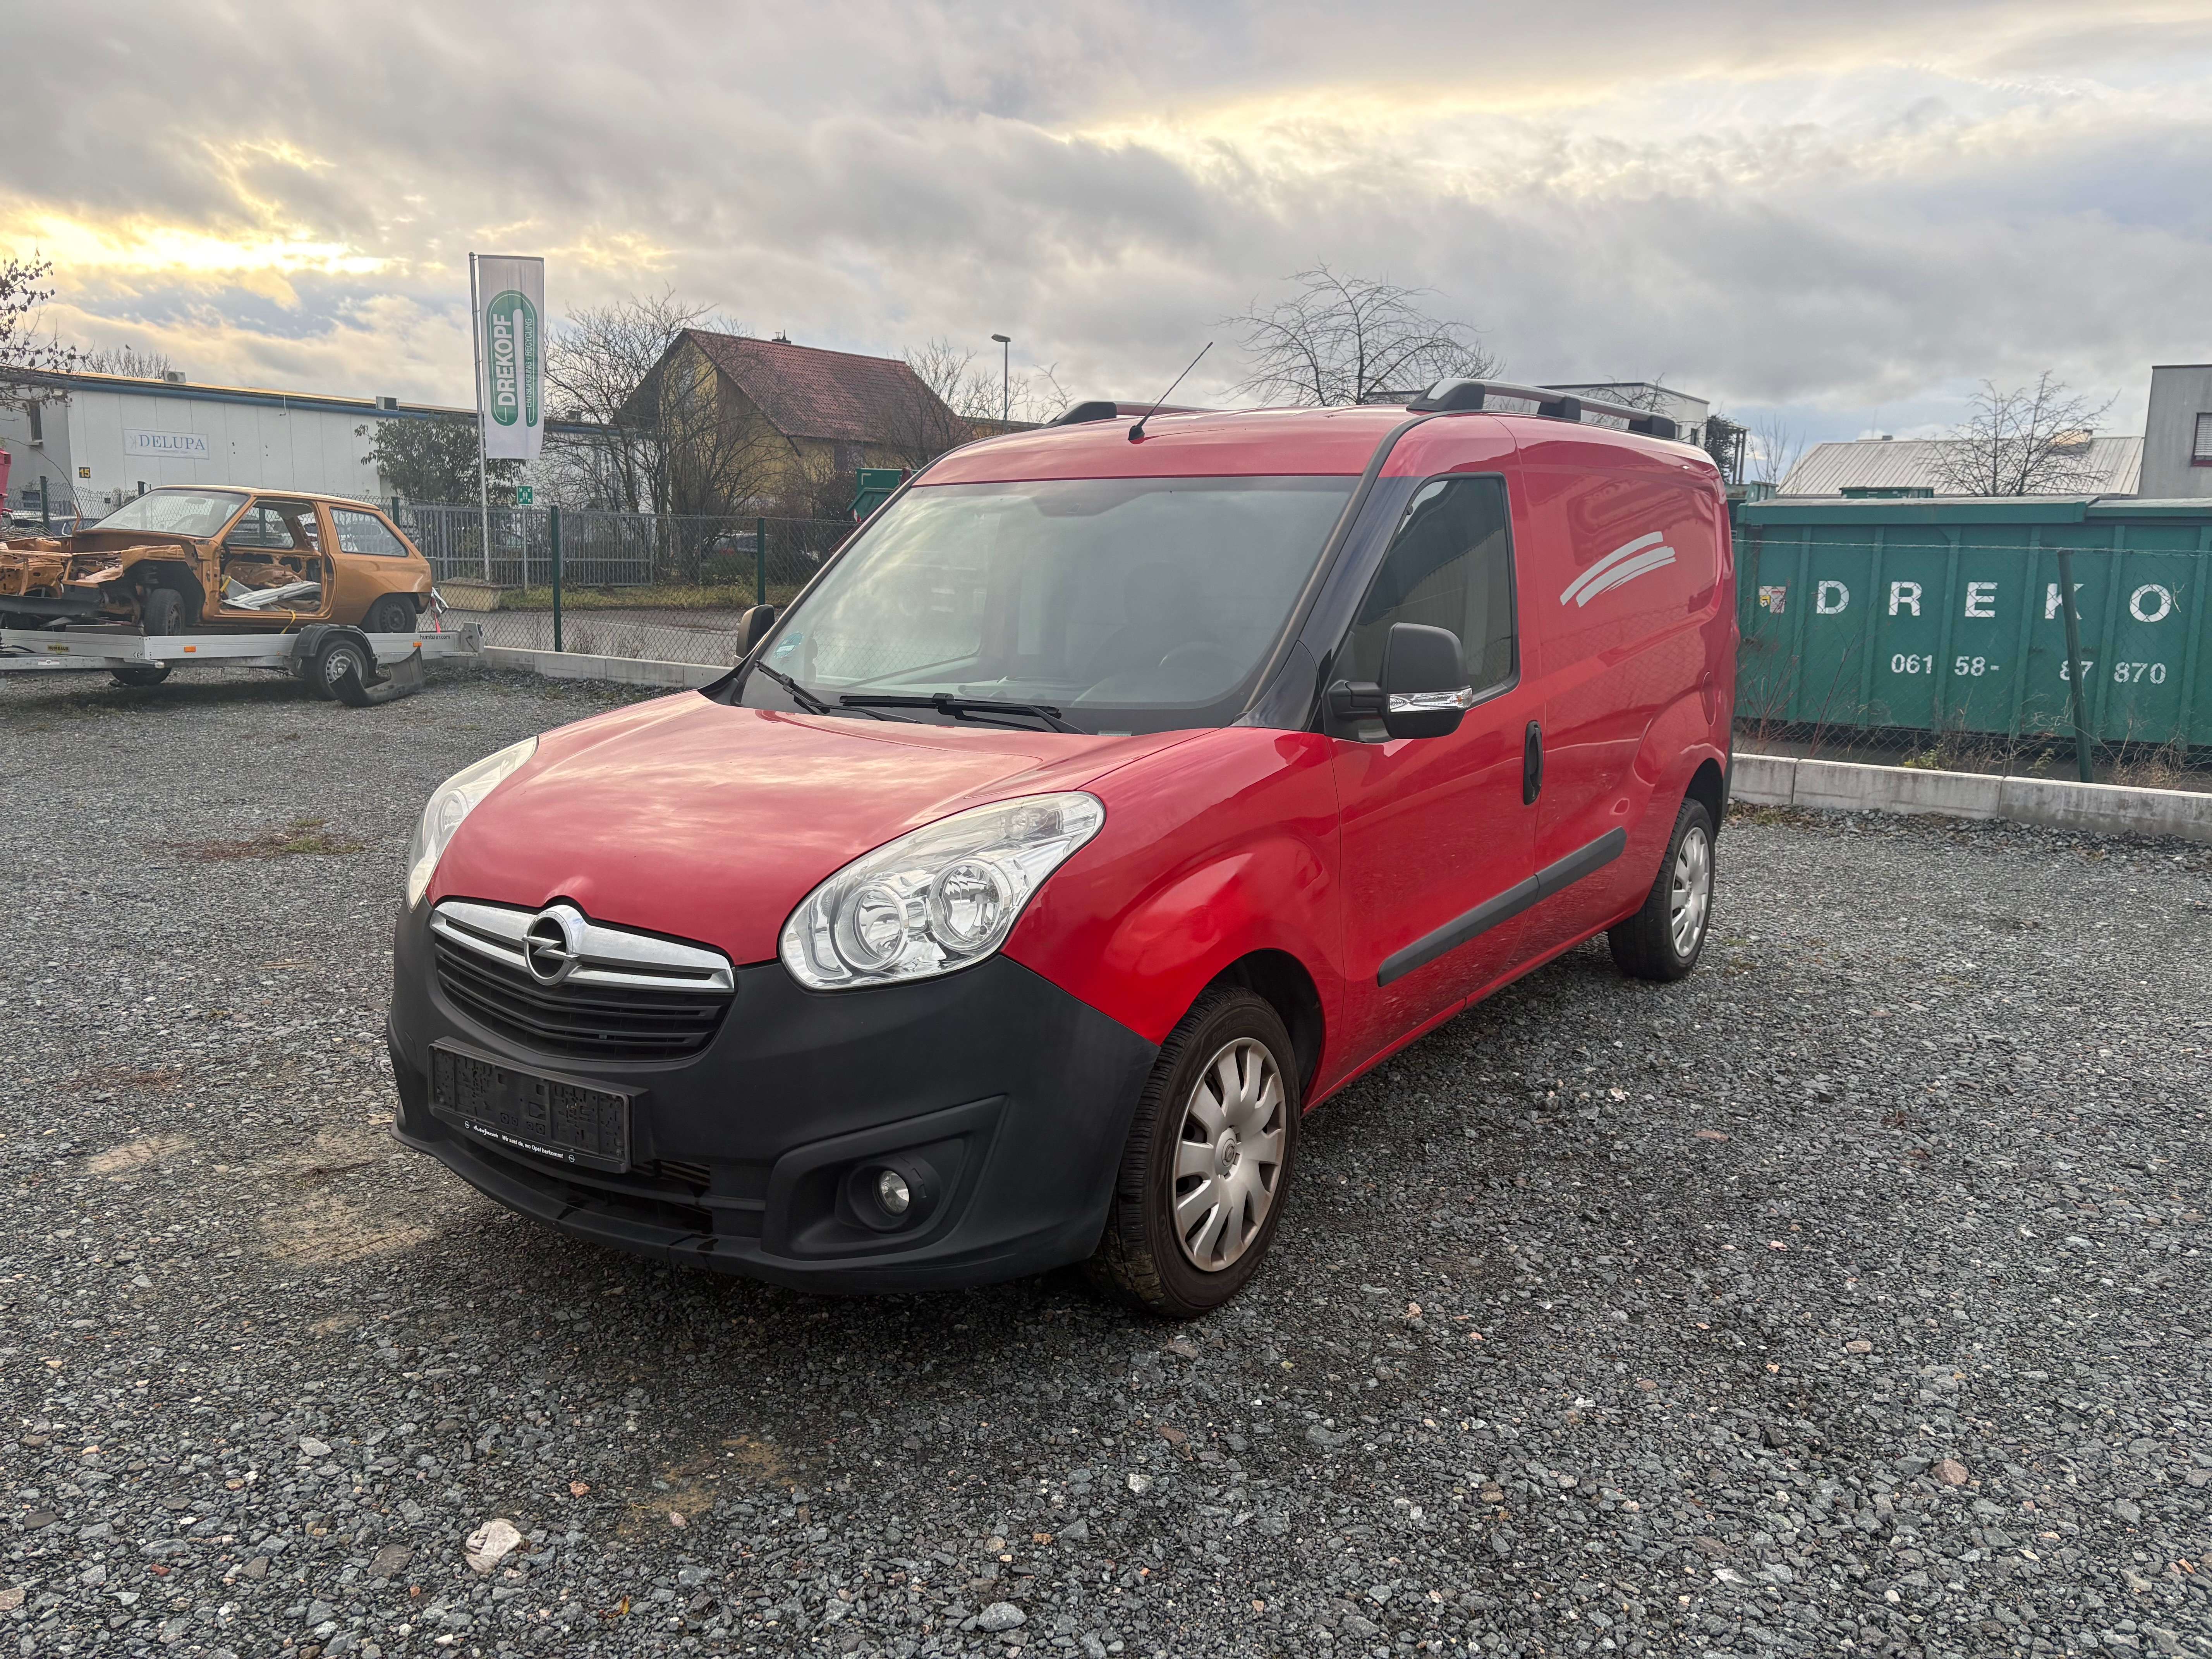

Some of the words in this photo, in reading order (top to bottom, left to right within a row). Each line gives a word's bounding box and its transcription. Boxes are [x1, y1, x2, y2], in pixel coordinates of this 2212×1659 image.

[525, 318, 533, 356] RECYCLING
[493, 313, 516, 406] DREKOPF
[138, 434, 205, 450] DELUPA
[79, 468, 90, 477] 15
[1816, 580, 2172, 623] DREKO
[1891, 654, 1933, 675] 061
[2114, 662, 2166, 684] 870
[542, 1148, 563, 1158] herkommt
